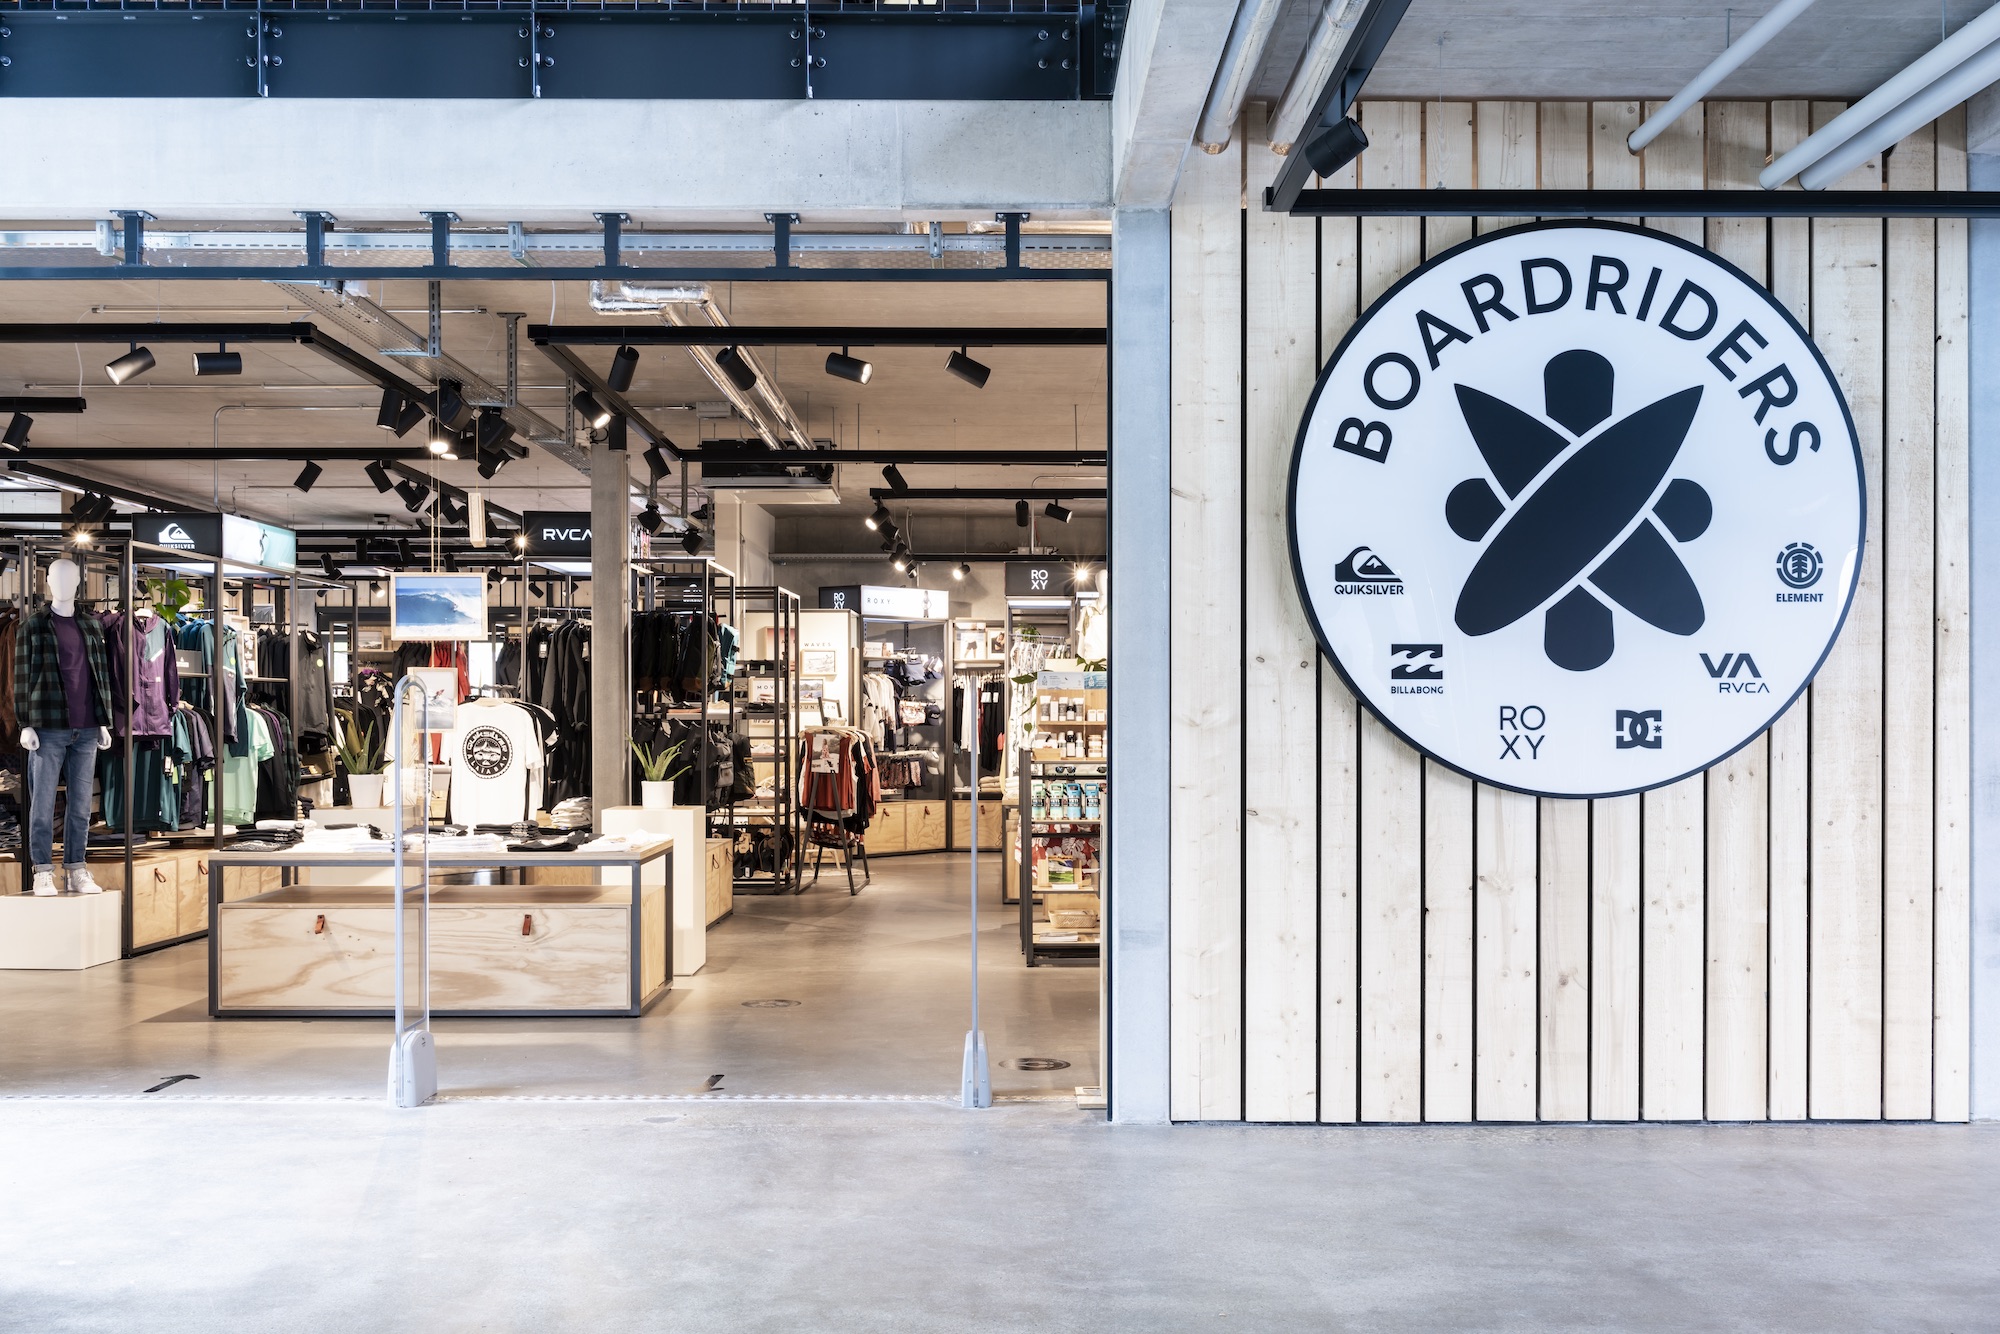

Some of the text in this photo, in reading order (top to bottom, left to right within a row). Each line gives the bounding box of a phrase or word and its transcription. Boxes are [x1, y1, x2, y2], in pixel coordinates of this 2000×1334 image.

[1333, 255, 1821, 466] BOARDRIDERS
[1031, 569, 1049, 580] RO
[1031, 580, 1048, 590] XY
[1334, 584, 1404, 595] QUIKSILVER
[833, 592, 845, 602] RO
[1776, 593, 1824, 602] ELEMENT
[1391, 686, 1443, 694] BILLABONG
[1719, 682, 1770, 693] RVCA
[1499, 705, 1546, 731] RO
[1616, 709, 1663, 749] DC
[1499, 735, 1546, 760] XY
